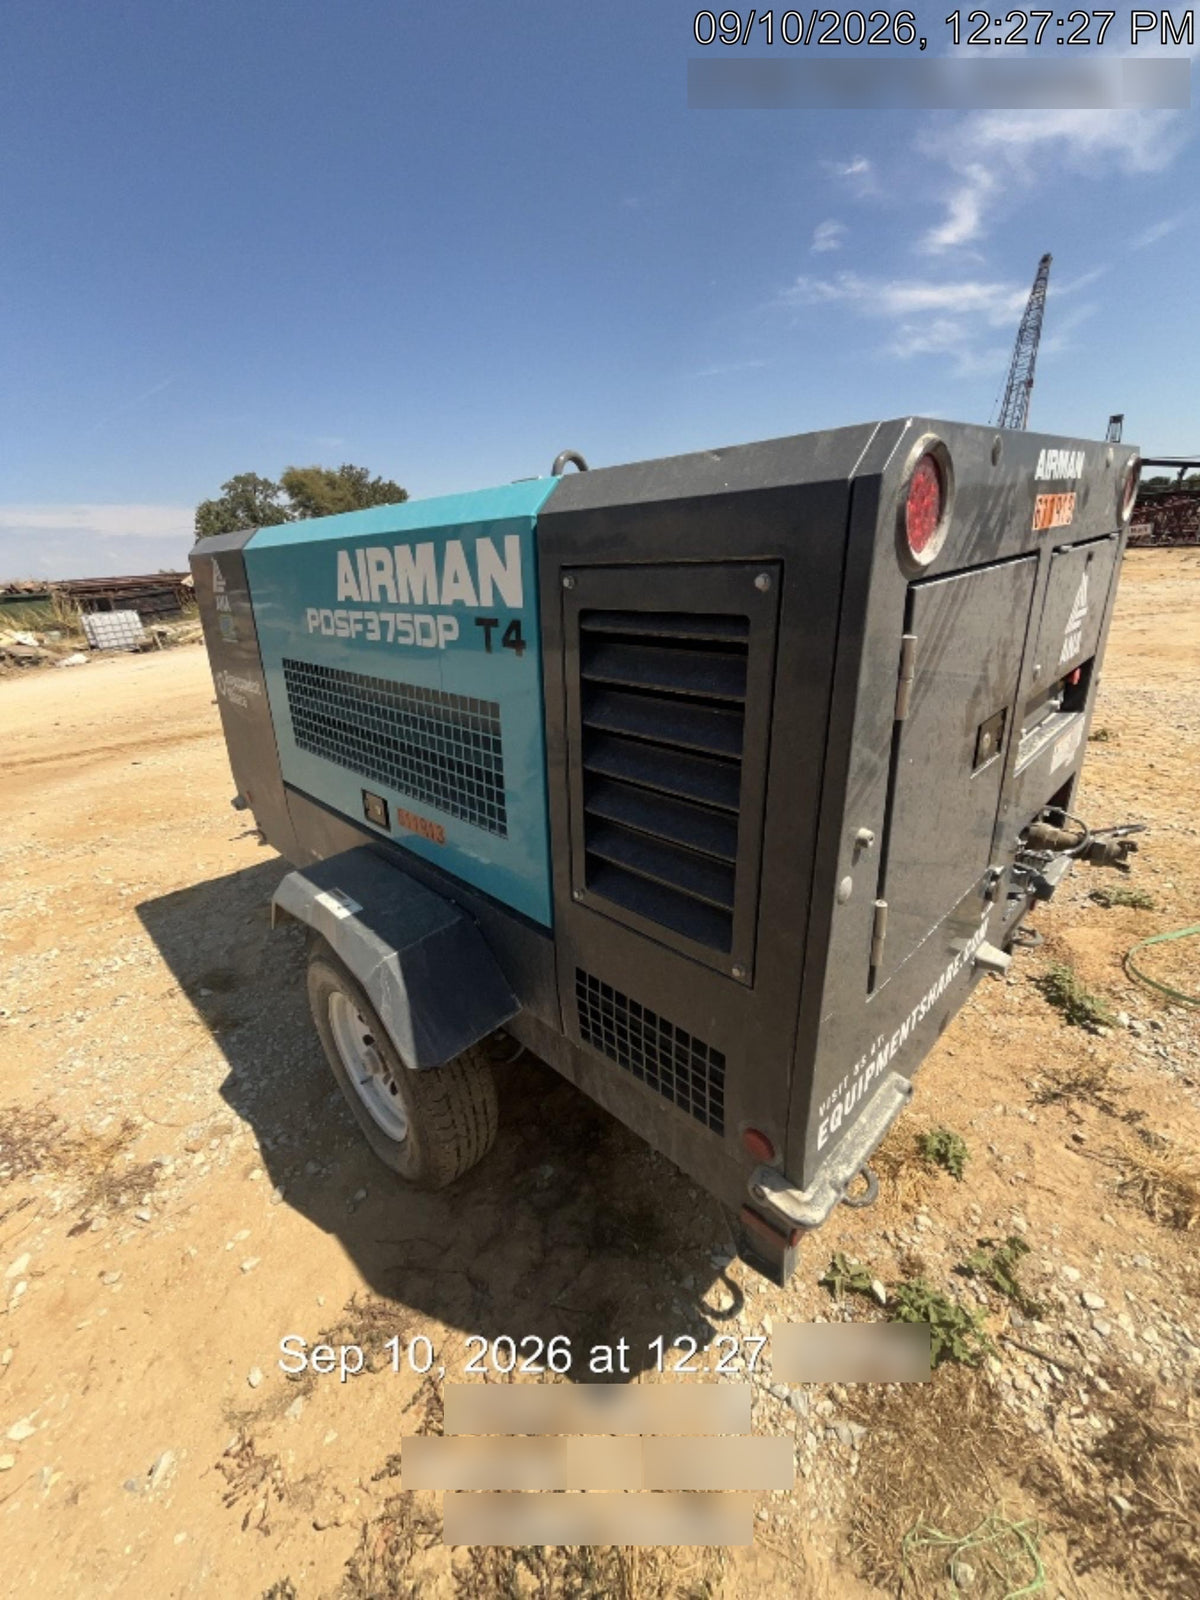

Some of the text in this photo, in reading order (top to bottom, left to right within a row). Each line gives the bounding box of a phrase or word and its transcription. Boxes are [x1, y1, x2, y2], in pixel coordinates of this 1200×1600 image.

[1034, 449, 1086, 480] AIRMAN
[336, 534, 524, 609] AIRMAN
[306, 607, 527, 657] PDSF375DP T4
